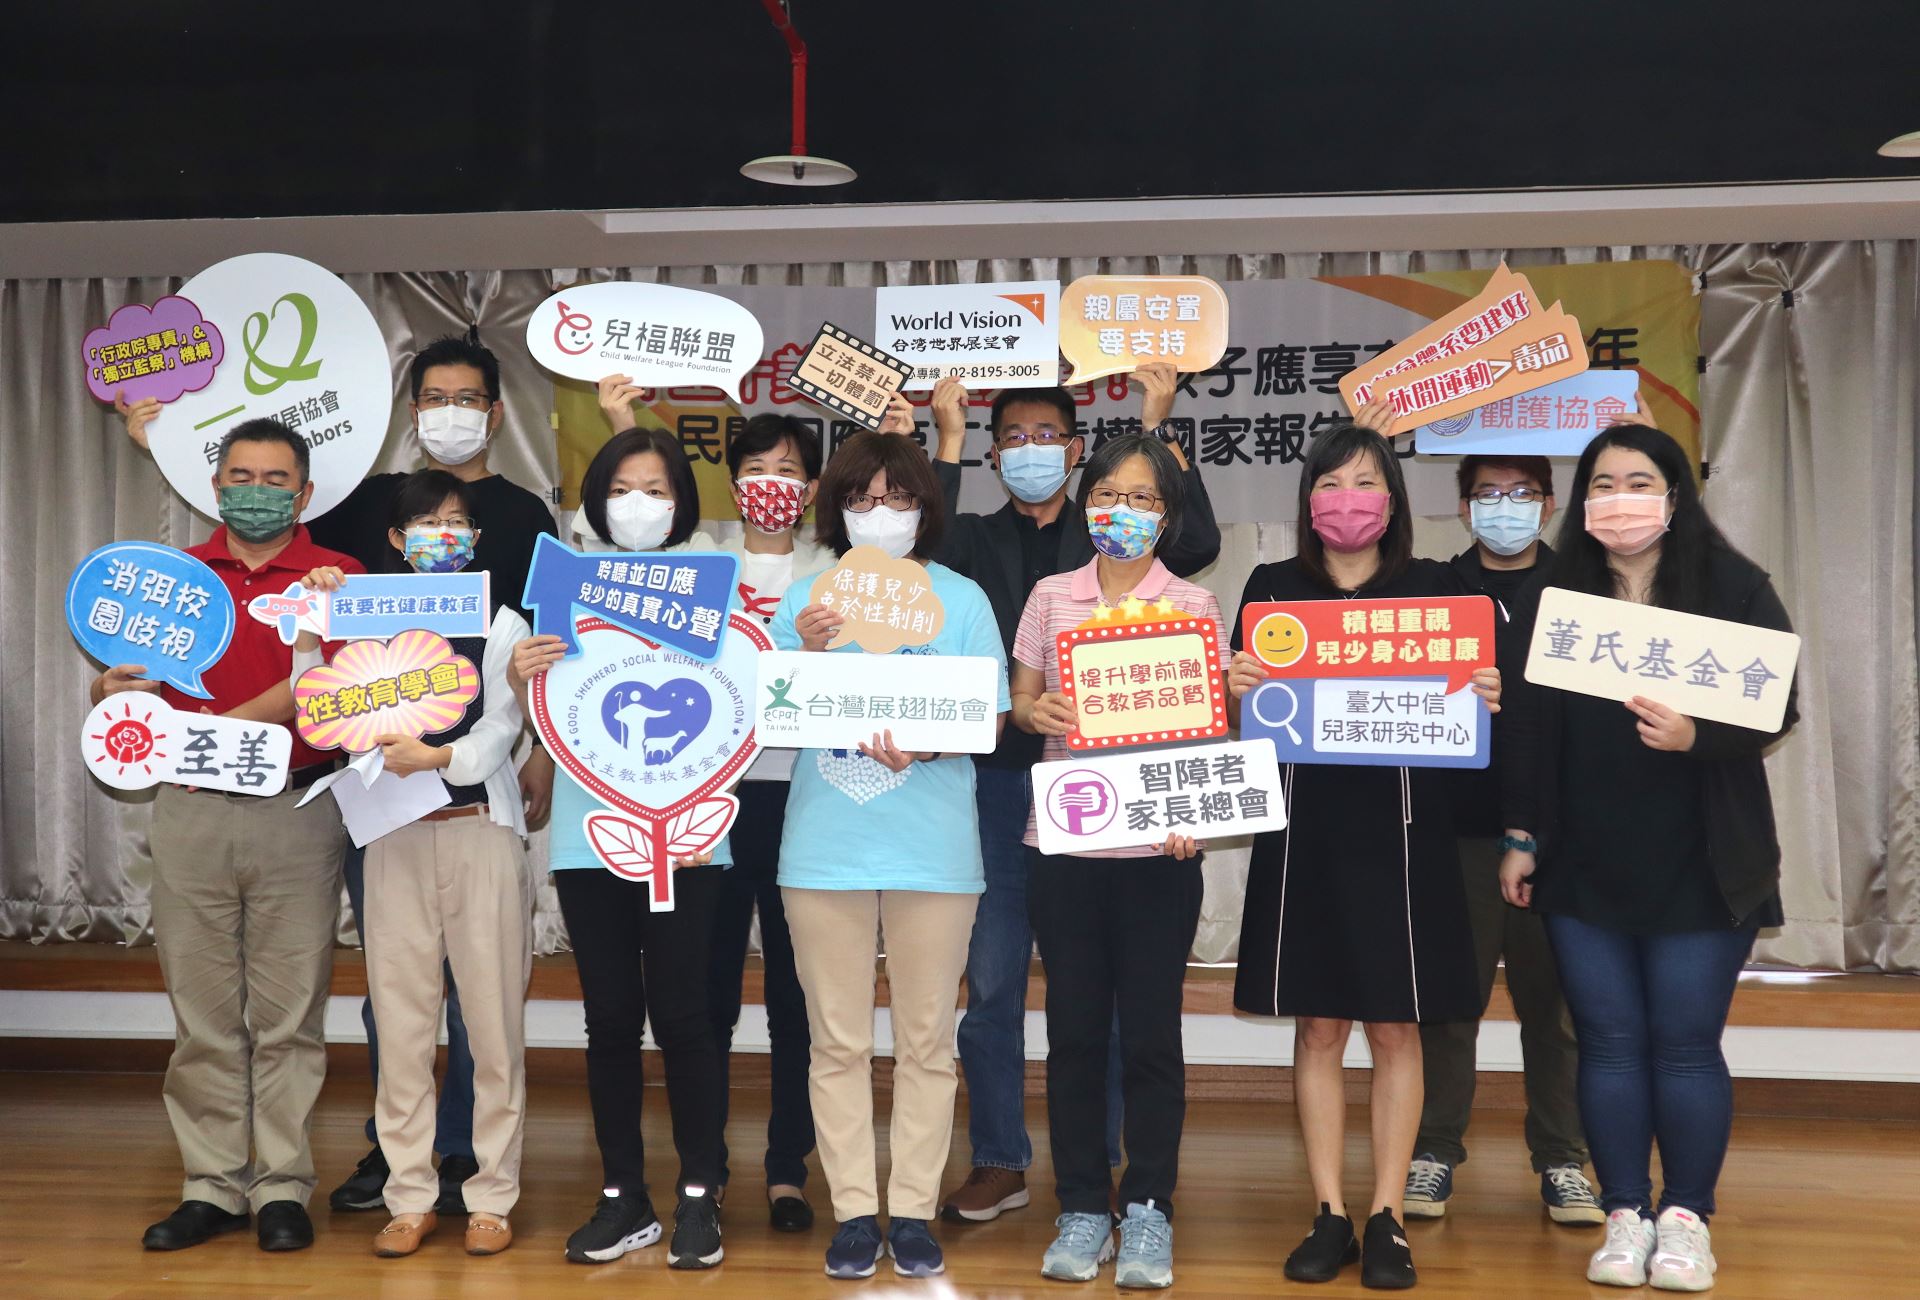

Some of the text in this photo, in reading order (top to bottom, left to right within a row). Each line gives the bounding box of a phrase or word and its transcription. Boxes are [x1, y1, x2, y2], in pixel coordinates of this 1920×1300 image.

[891, 311, 1022, 331] World Vision
[1084, 294, 1200, 323] 親屬安置
[602, 319, 736, 364] 兒福聯盟
[1098, 328, 1187, 358] 要支持
[600, 350, 732, 374] Child Welfare League Foundation
[816, 343, 894, 392] 立法禁止
[950, 364, 1040, 378] 02-8195-3005
[808, 363, 885, 409] 一切體罰
[103, 558, 210, 619] 消弭校
[597, 560, 698, 596] 聆聽並回應
[833, 569, 926, 605] 保護兒少
[334, 594, 479, 616] 我要性健康教育
[578, 582, 722, 642] 兒少的真實心聲
[1342, 608, 1452, 635] 積極重視
[88, 597, 195, 661] 園歧視
[1316, 638, 1480, 665] 兒少身心健康
[1543, 617, 1780, 702] 董氏基金會
[1079, 659, 1203, 689] 提升學前融
[306, 661, 460, 725] 性教育學會
[567, 653, 745, 735] GOOD SHEPHERD SOCIAL WELFARE FOUNDATION
[806, 693, 989, 722] 台灣展翅協會
[1082, 684, 1205, 715] 合教育品質
[1346, 690, 1446, 716] 臺大中信
[766, 724, 800, 732] TAIWAN
[1321, 719, 1470, 746] 兒家研究中心
[175, 727, 277, 787] 至善
[581, 741, 732, 785] 天主教善牧基金會
[1139, 753, 1246, 795] 智障者
[1124, 786, 1270, 831] 家長總會
